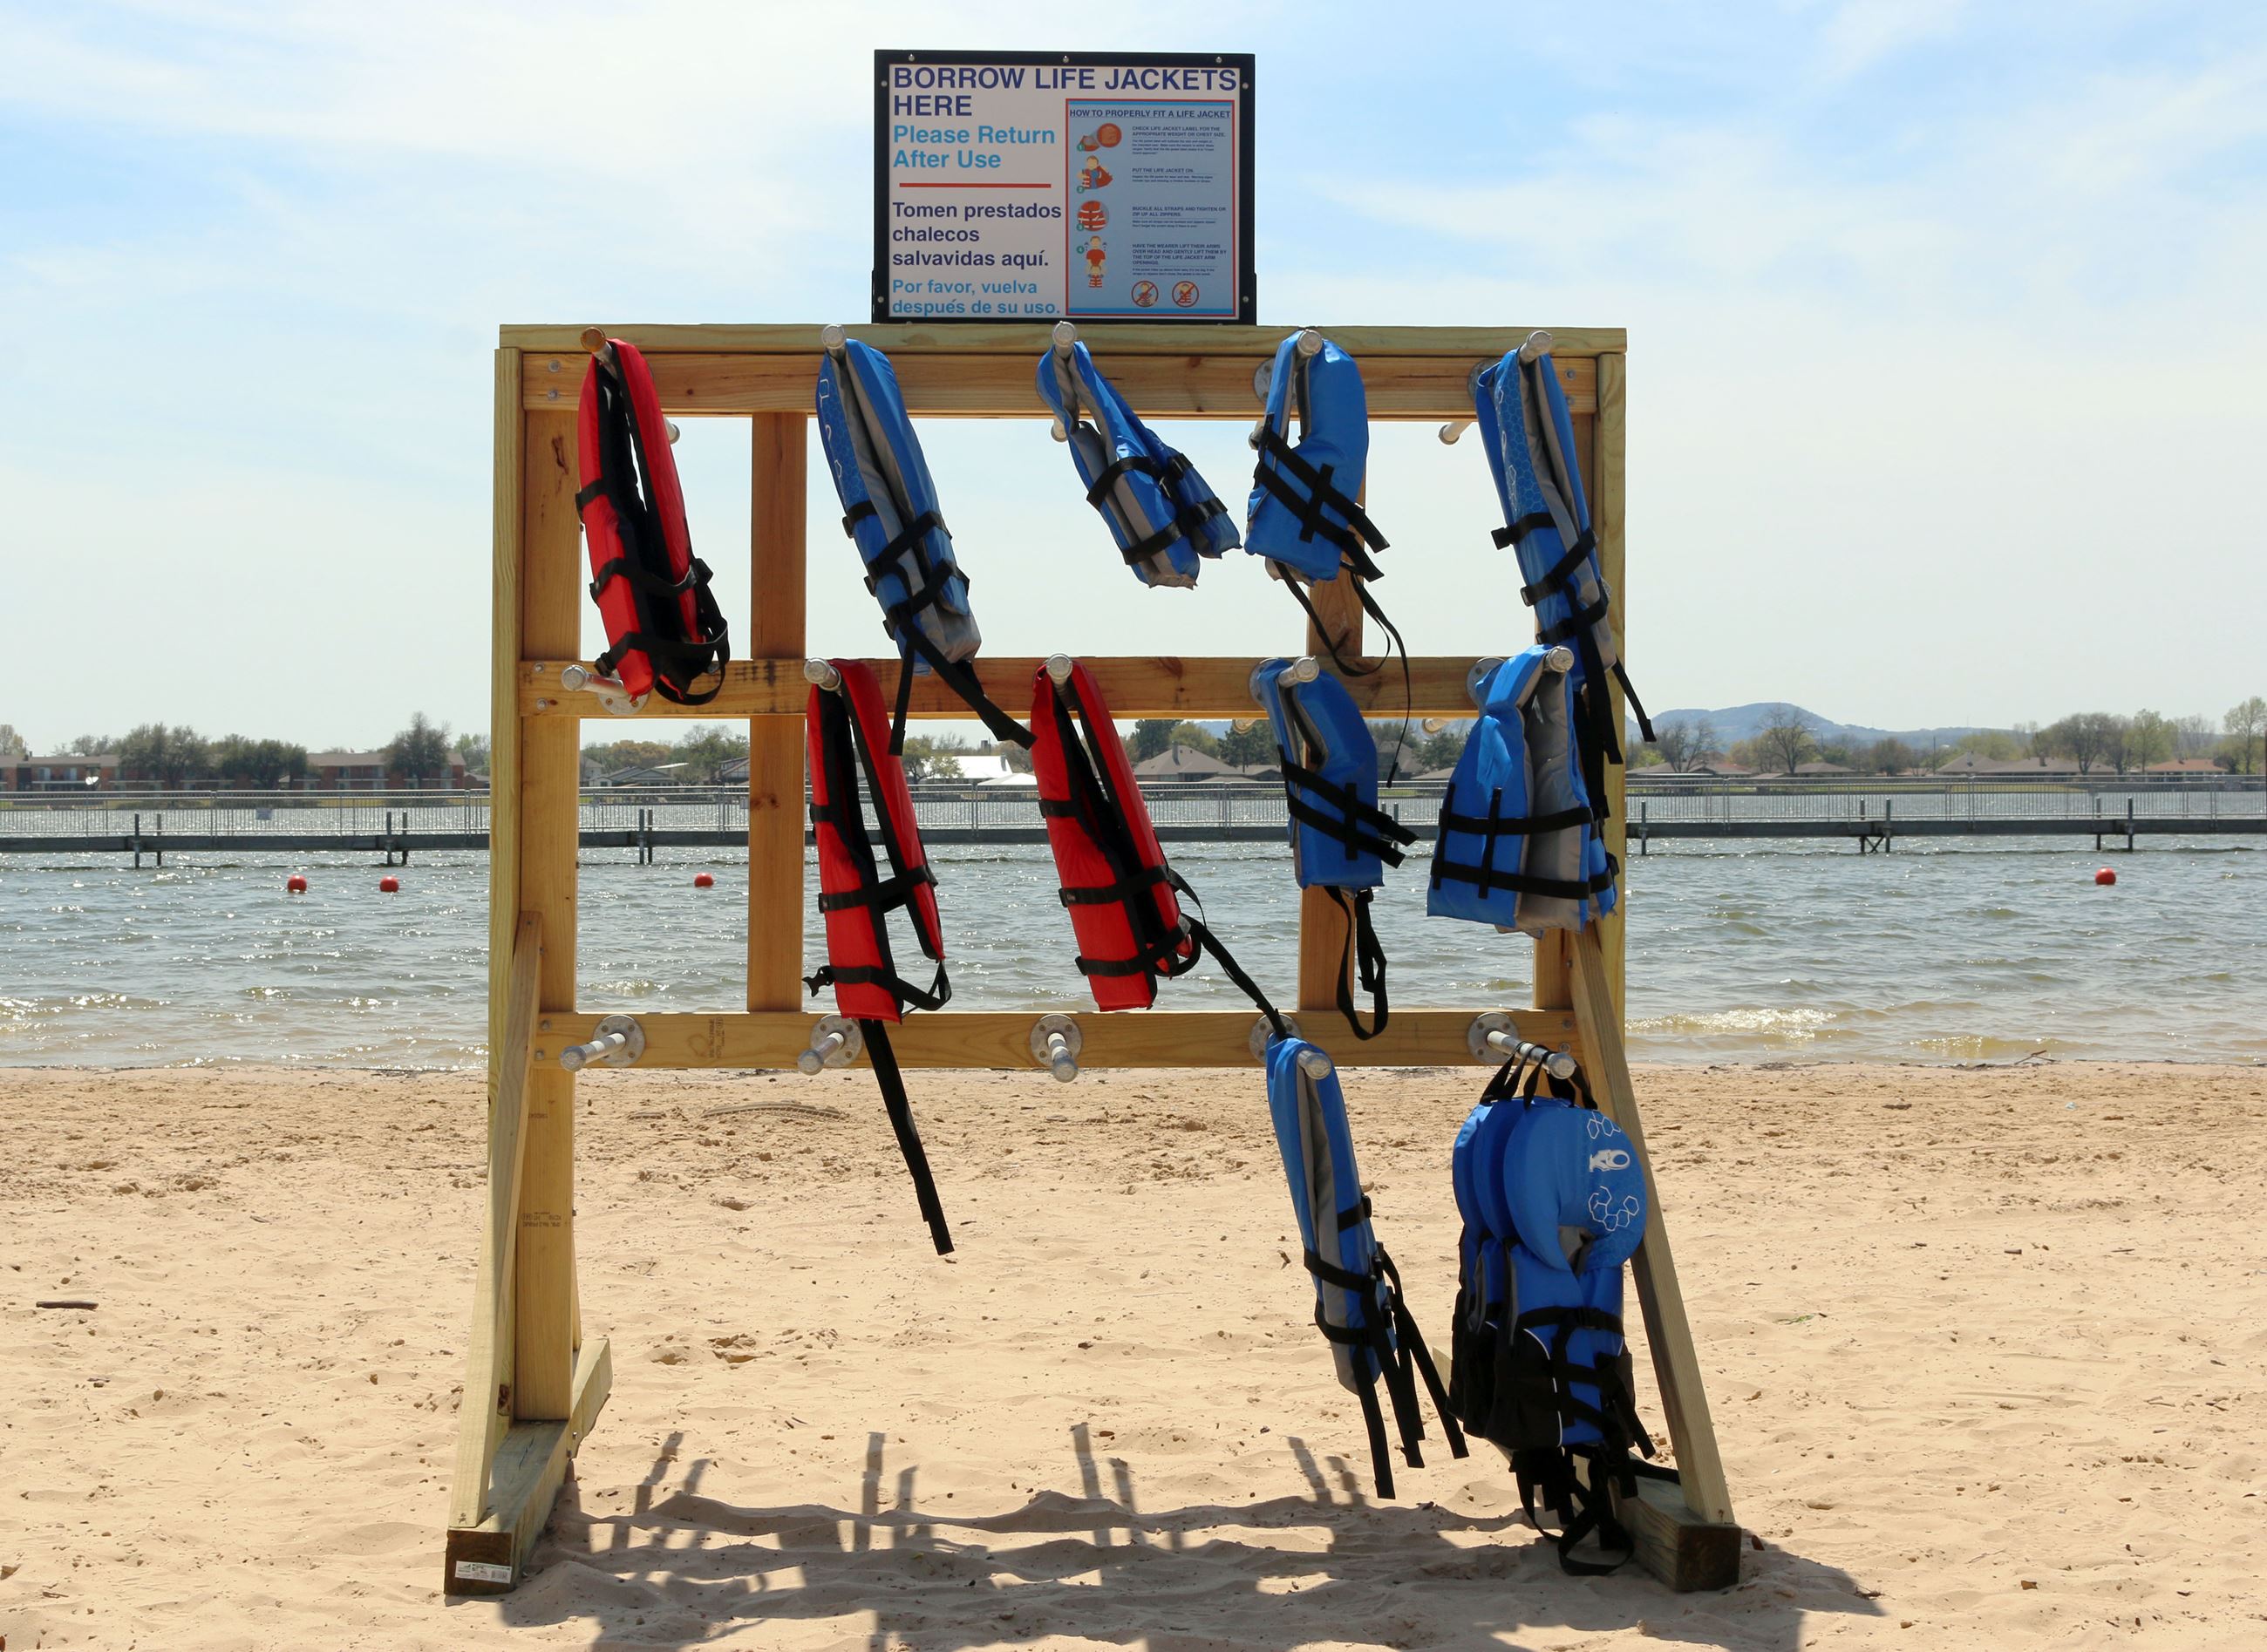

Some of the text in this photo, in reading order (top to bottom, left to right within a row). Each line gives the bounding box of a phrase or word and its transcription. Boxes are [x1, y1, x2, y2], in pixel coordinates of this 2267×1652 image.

[894, 67, 1237, 91] BORROW LIFE JACKETS
[894, 95, 972, 116] HERE
[1069, 109, 1090, 118] HOW
[1176, 110, 1195, 119] LIFE
[1197, 110, 1231, 119] JACKET
[894, 125, 1055, 144] Please Return
[893, 150, 1002, 168] After Use
[893, 201, 1062, 221] Tomen prestados
[892, 227, 980, 242] chalecos
[892, 250, 1049, 270] salvavidas aquí.
[893, 279, 1038, 296] Por favor, vuelva
[892, 299, 1060, 316] después de su uso.
